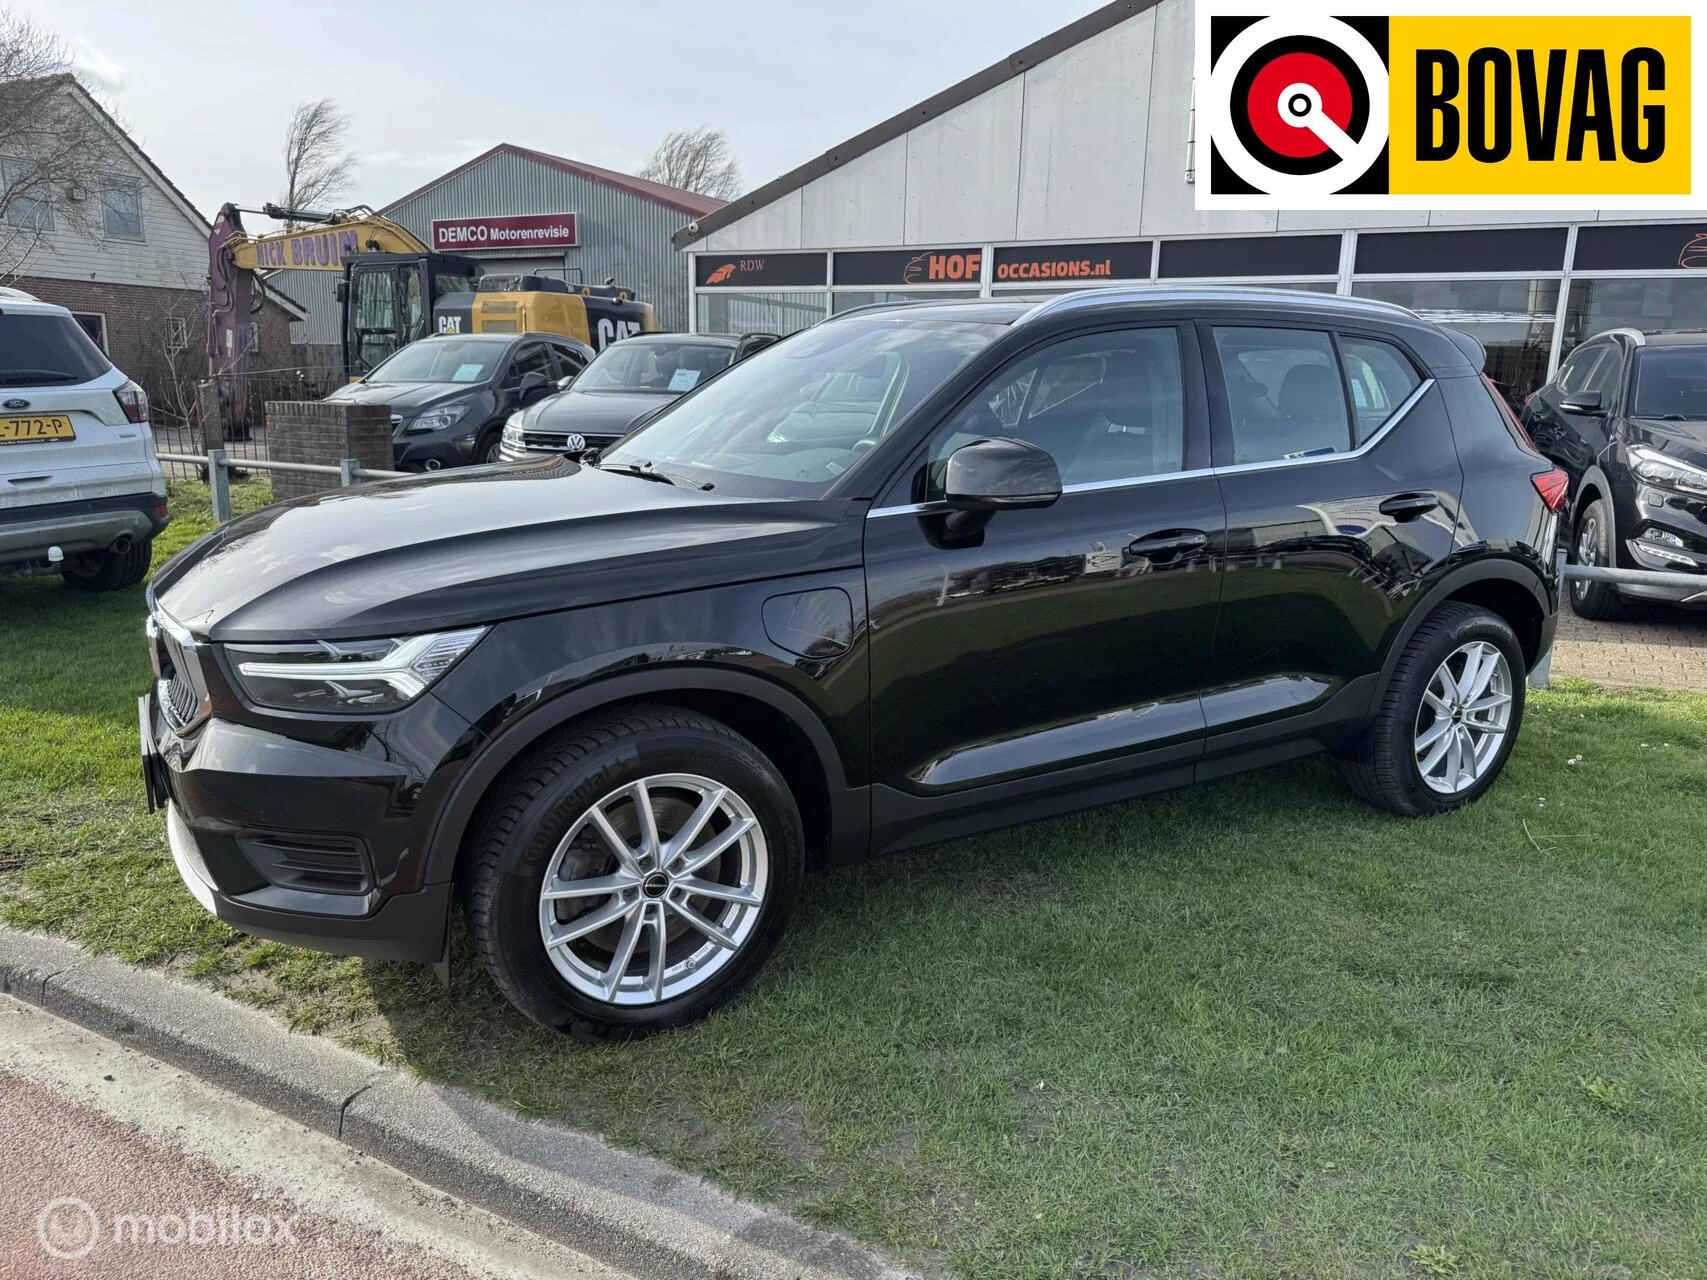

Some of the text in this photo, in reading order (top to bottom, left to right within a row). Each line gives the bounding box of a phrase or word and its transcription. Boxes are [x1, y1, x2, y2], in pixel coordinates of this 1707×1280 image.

[438, 225, 569, 243] DEMCO Motorenrevisie
[291, 229, 358, 266] BRUIN
[740, 259, 765, 272] RDW
[928, 254, 1111, 280] HOF OCCASIONS.nl
[438, 316, 462, 334] CAT
[0, 418, 63, 437] -772-P
